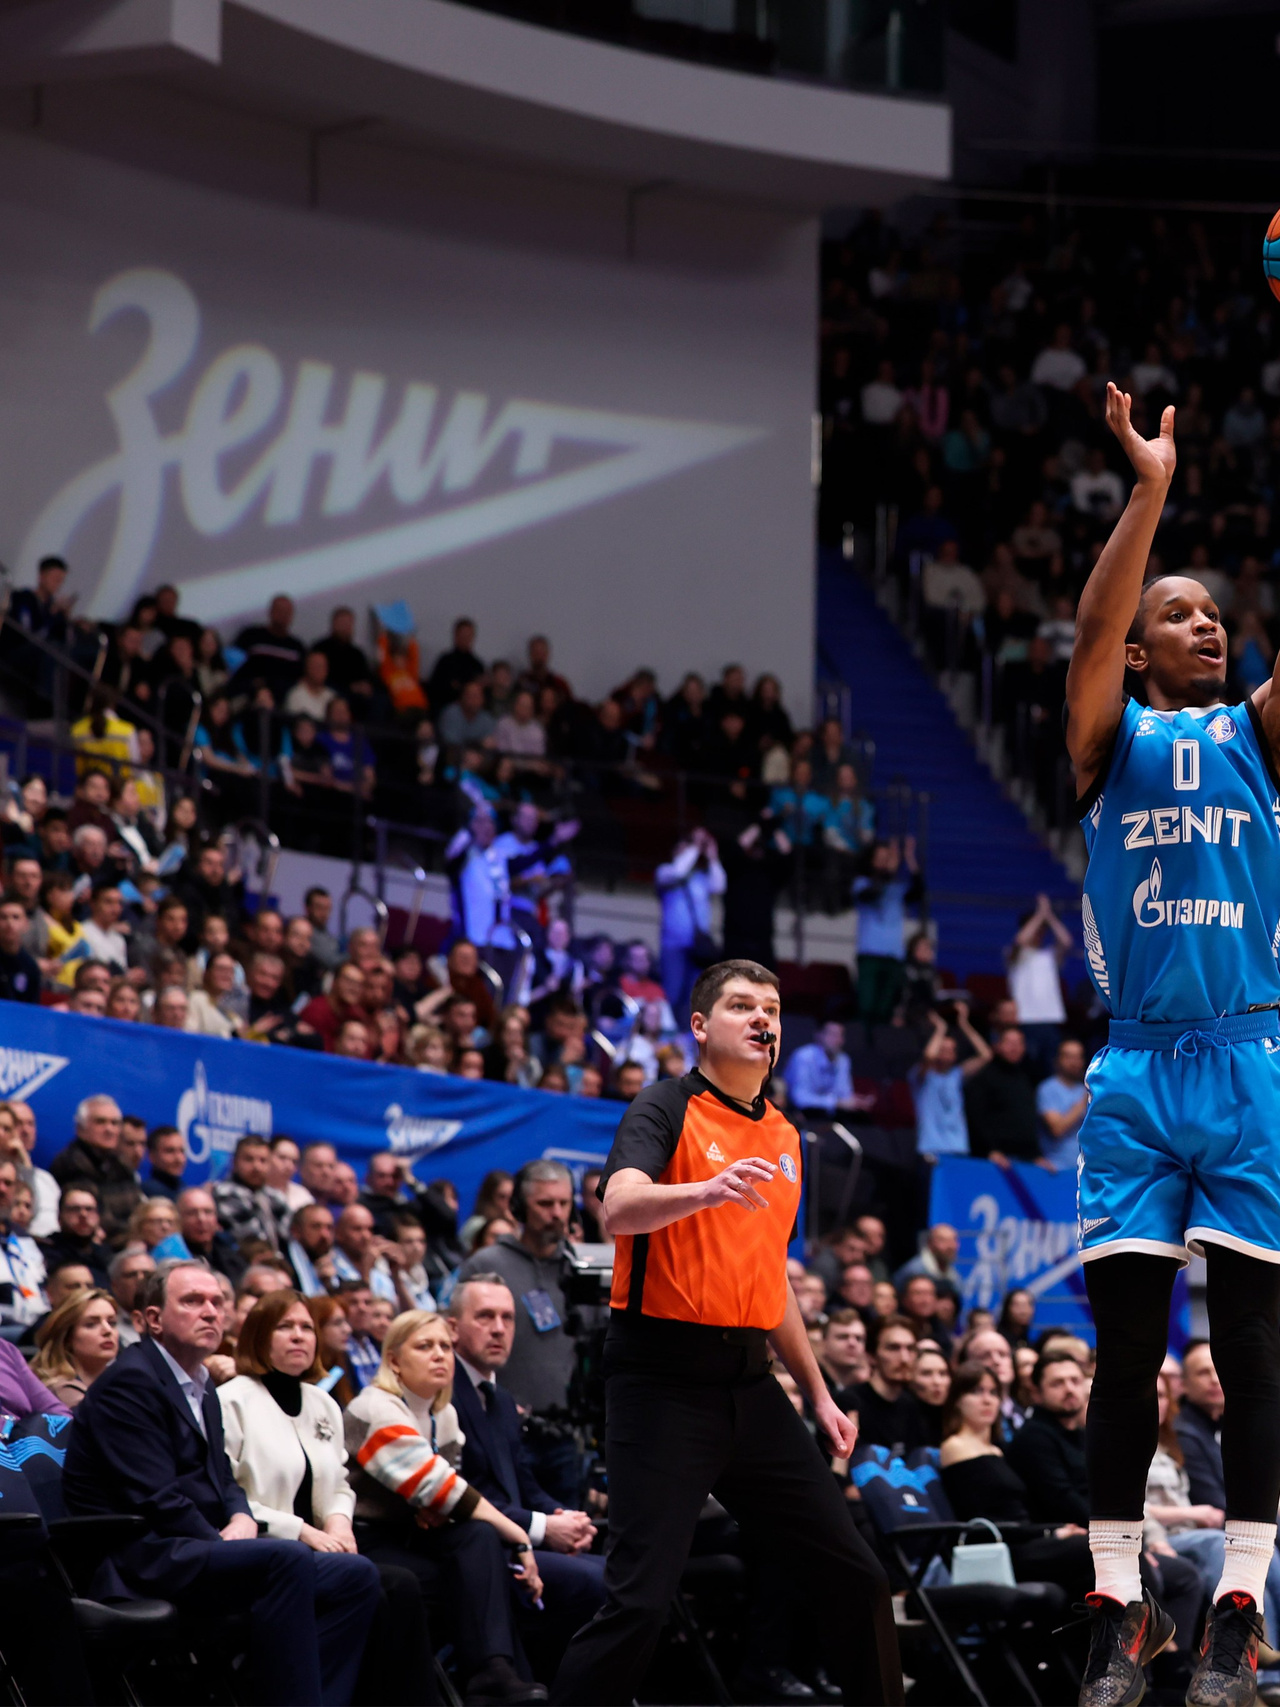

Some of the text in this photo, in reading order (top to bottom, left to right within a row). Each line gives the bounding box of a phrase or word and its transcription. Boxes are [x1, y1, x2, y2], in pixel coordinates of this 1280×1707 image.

[1135, 729, 1156, 737] ELME
[1172, 738, 1200, 791] 0
[1120, 805, 1252, 851] ZENIT
[1166, 898, 1245, 930] ГАЗПРОМ
[706, 1151, 726, 1163] PEAK
